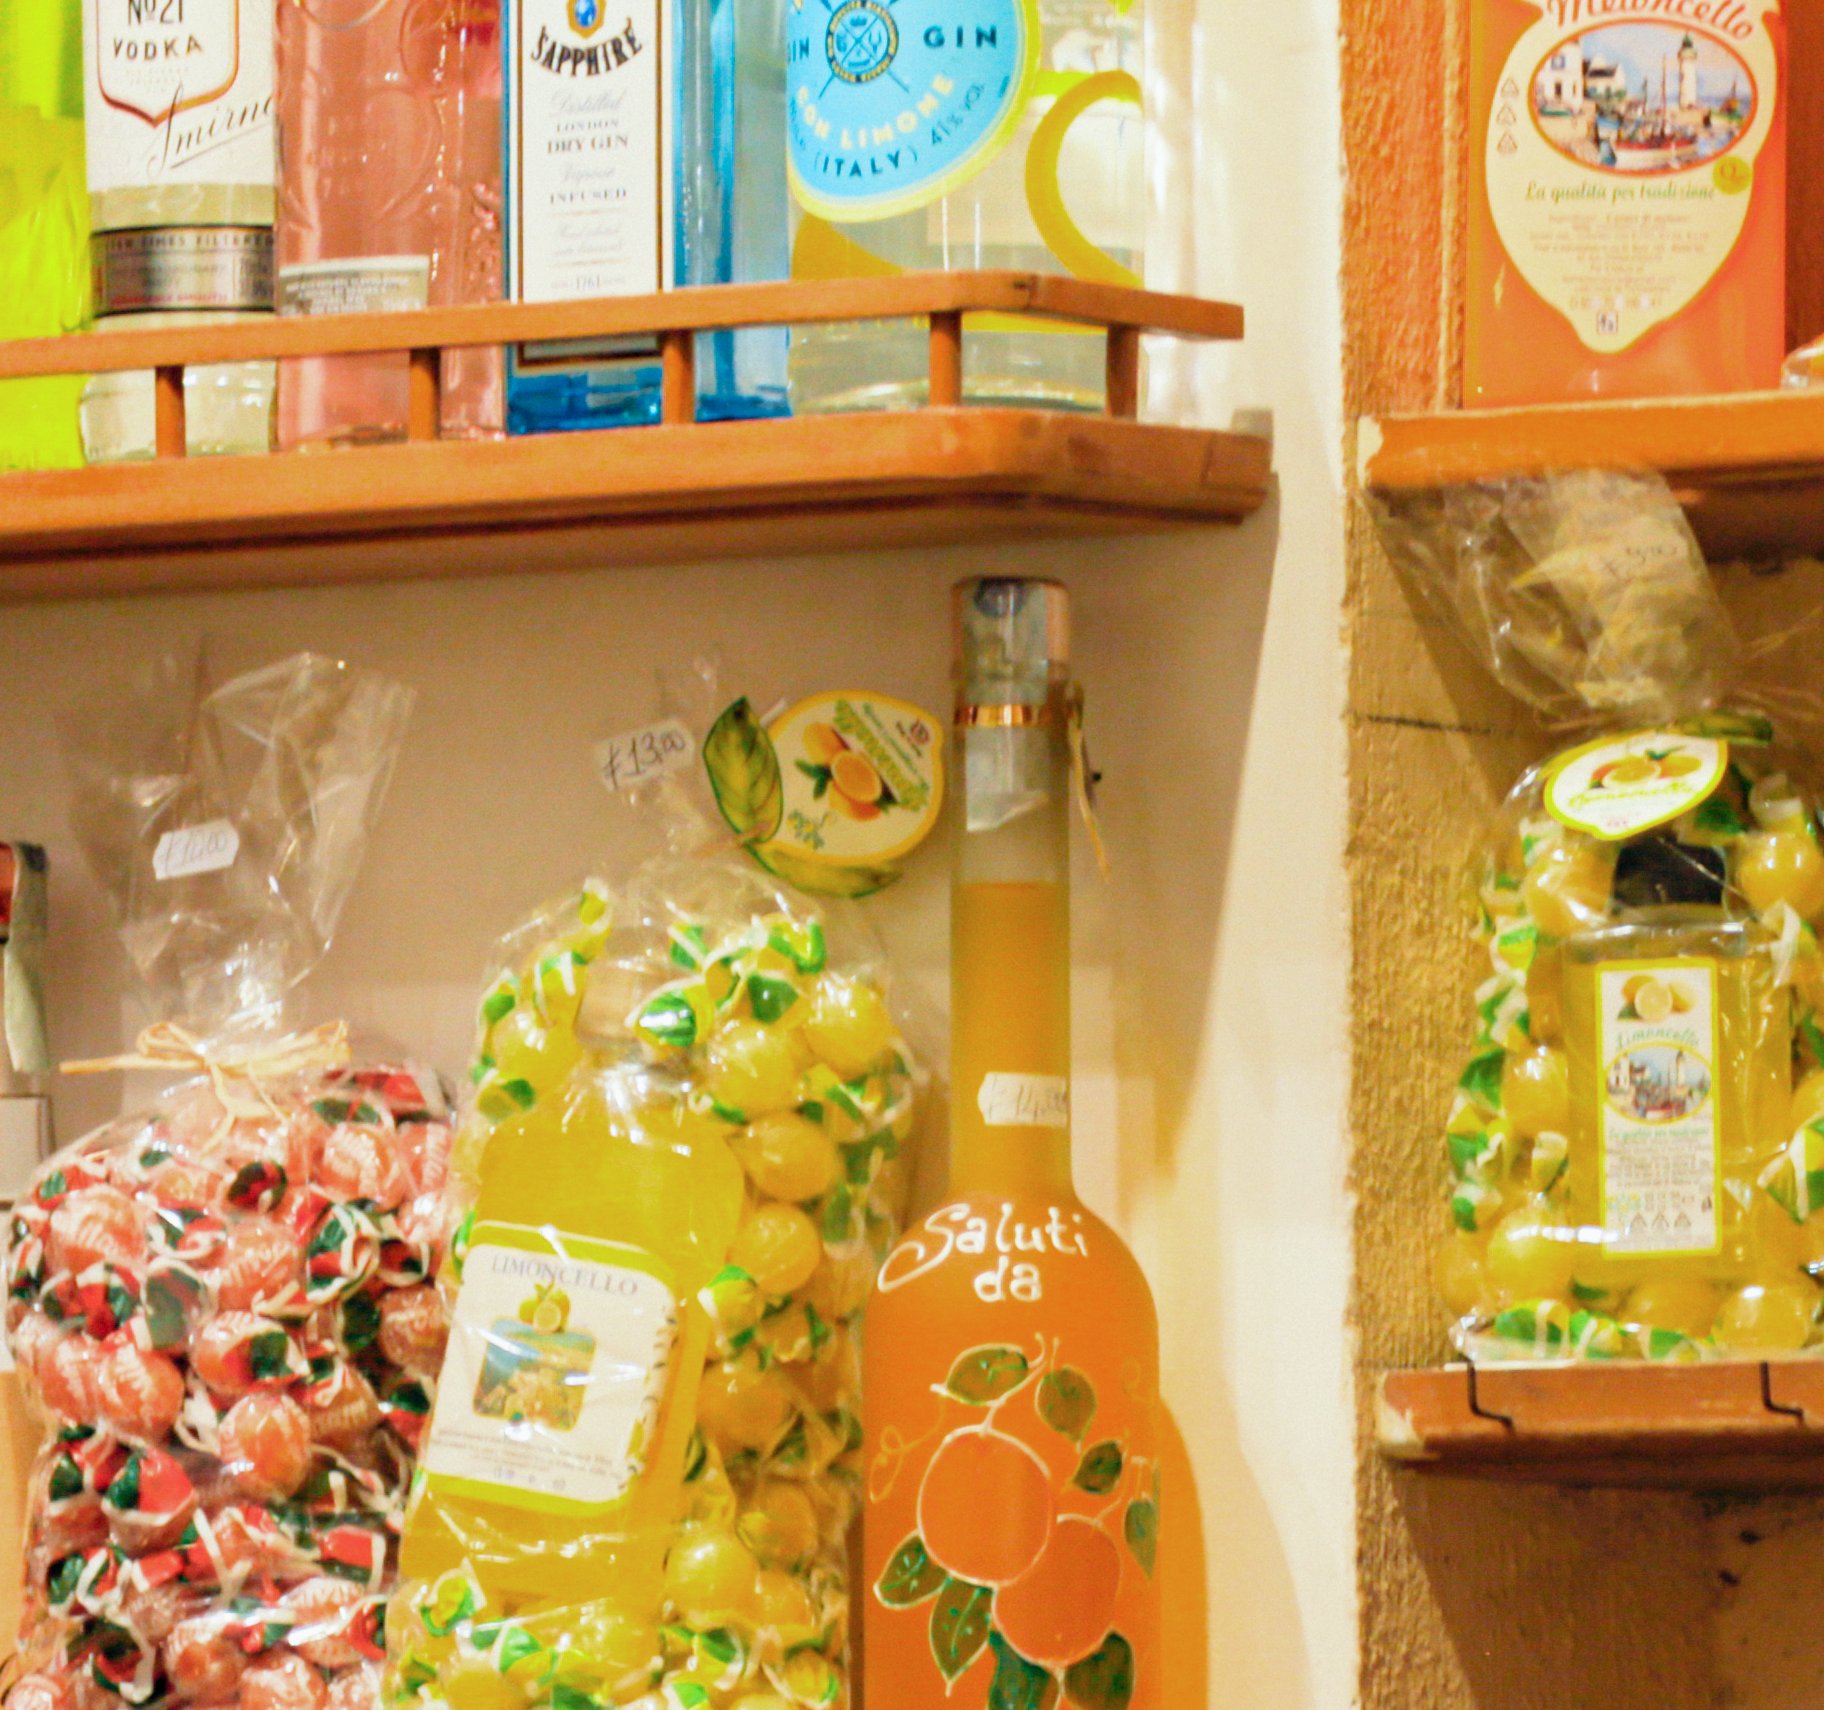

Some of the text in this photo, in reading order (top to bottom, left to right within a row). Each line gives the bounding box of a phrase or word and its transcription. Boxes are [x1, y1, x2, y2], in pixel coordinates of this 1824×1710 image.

[112, 35, 204, 61] VODKA
[530, 16, 644, 78] SAPPHIRE
[923, 25, 997, 49] GIN
[840, 74, 955, 150] LIMONE
[547, 135, 629, 154] DRY GIN
[877, 1202, 1089, 1293] Saluti
[491, 1251, 640, 1298] LIMONCELLO
[972, 1255, 1044, 1303] da
